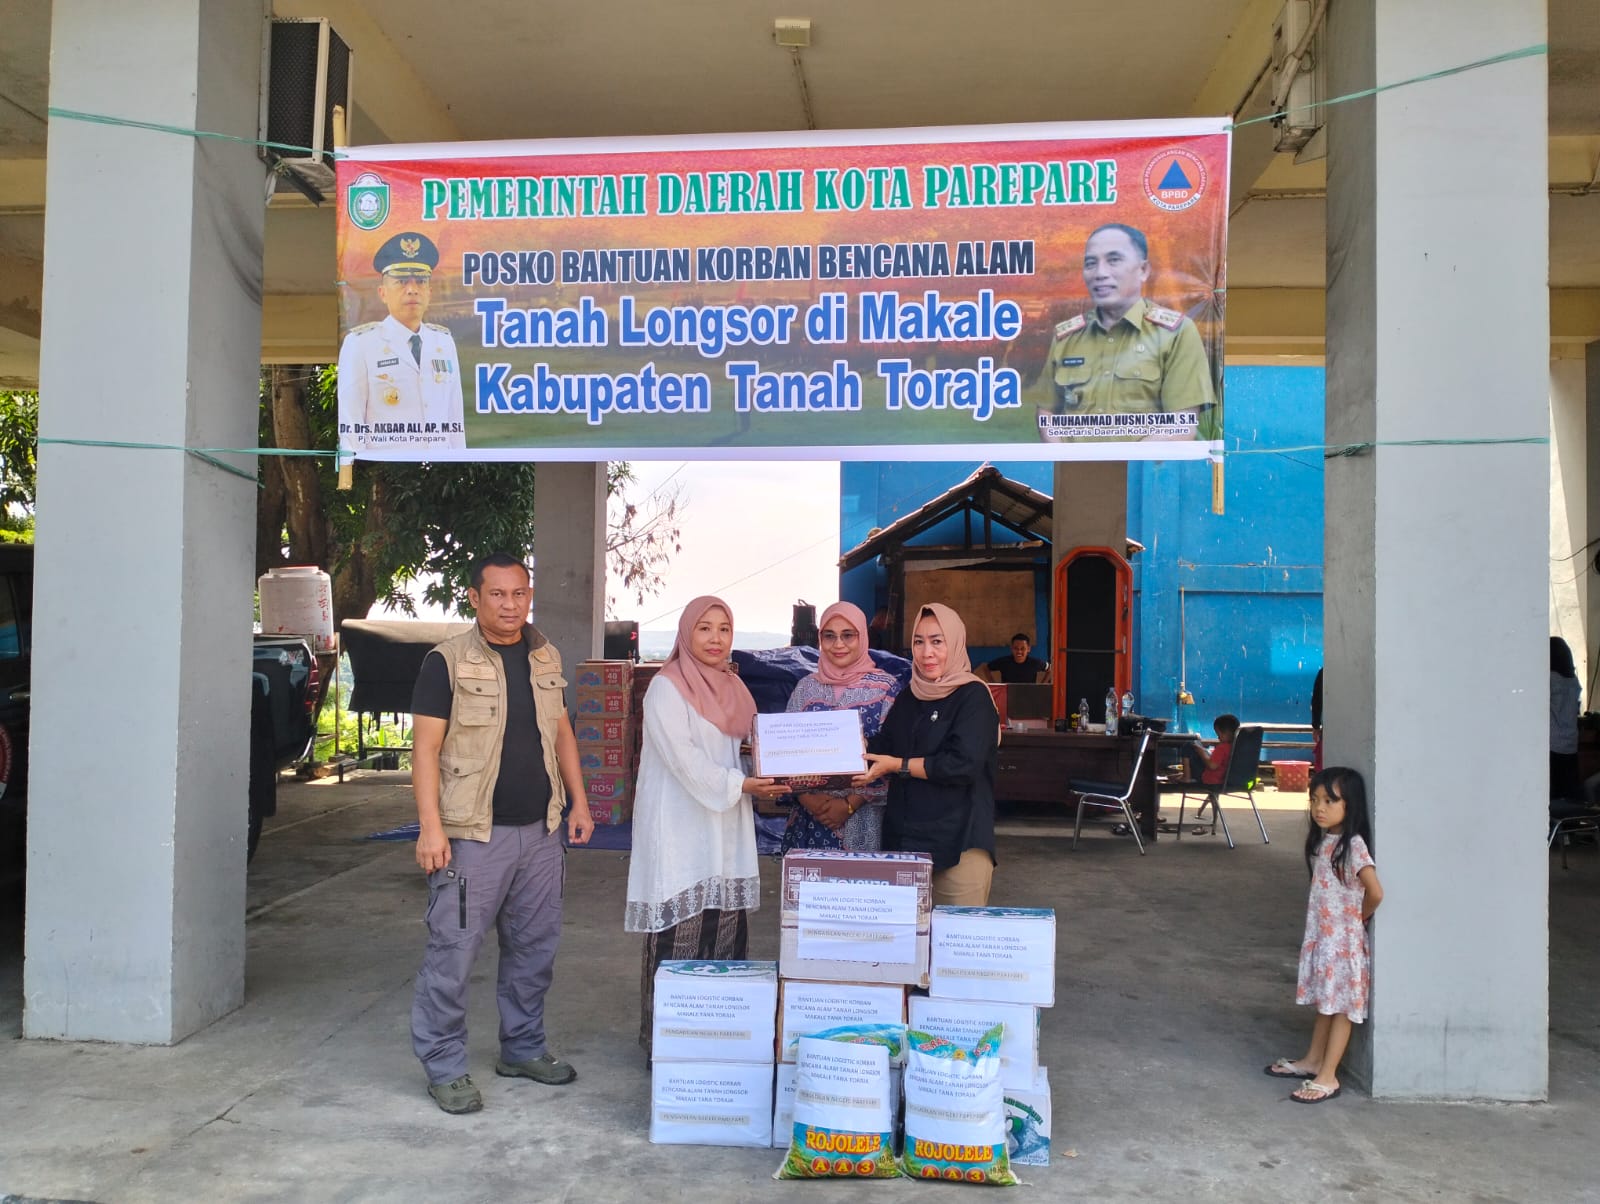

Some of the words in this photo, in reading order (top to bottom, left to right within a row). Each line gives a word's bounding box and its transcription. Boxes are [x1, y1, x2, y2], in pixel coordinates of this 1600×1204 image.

[421, 173, 649, 221] PEMERINTAH
[657, 169, 804, 219] DAERAH
[815, 165, 913, 212] KOTA
[923, 159, 1118, 209] PAREPARE
[1161, 190, 1188, 199] BPBD
[1153, 198, 1167, 208] KOTA
[1168, 196, 1197, 210] PAREPARE
[463, 250, 555, 287] POSKO
[560, 248, 690, 286] BANTUAN
[697, 245, 810, 283] KORBAN
[818, 242, 950, 281] BENCANA
[955, 240, 1035, 276] ALAM
[474, 296, 607, 349] Tanah
[618, 294, 798, 359] Longsor
[805, 291, 848, 344] di
[859, 289, 1022, 343] Makale
[475, 361, 711, 425] Kabupaten
[726, 359, 860, 412] Tanah
[878, 357, 1022, 421] Toraja
[1040, 416, 1050, 427] H.
[1052, 415, 1112, 427] MUHAMMAD
[1115, 415, 1145, 426] HUSNI
[1148, 414, 1177, 426] SYAM,
[1180, 414, 1198, 425] S.H.
[340, 423, 352, 433] Dr.
[354, 423, 372, 433] Drs.
[374, 422, 405, 433] AKBAR
[407, 422, 423, 434] ALI,
[441, 422, 464, 433] M.Si.
[1048, 428, 1092, 436] Sekertaris
[1094, 428, 1125, 436] Daerah
[1150, 427, 1190, 436] Parepare
[410, 435, 446, 444] Parepare
[591, 784, 614, 793] ROSI
[806, 1131, 881, 1154] ROJOLELE
[915, 1140, 993, 1162] ROJOLELE
[814, 1161, 827, 1171] A
[838, 1162, 849, 1172] A
[860, 1162, 872, 1172] 3
[926, 1168, 936, 1177] A
[947, 1170, 958, 1178] A
[970, 1170, 981, 1180] 3
